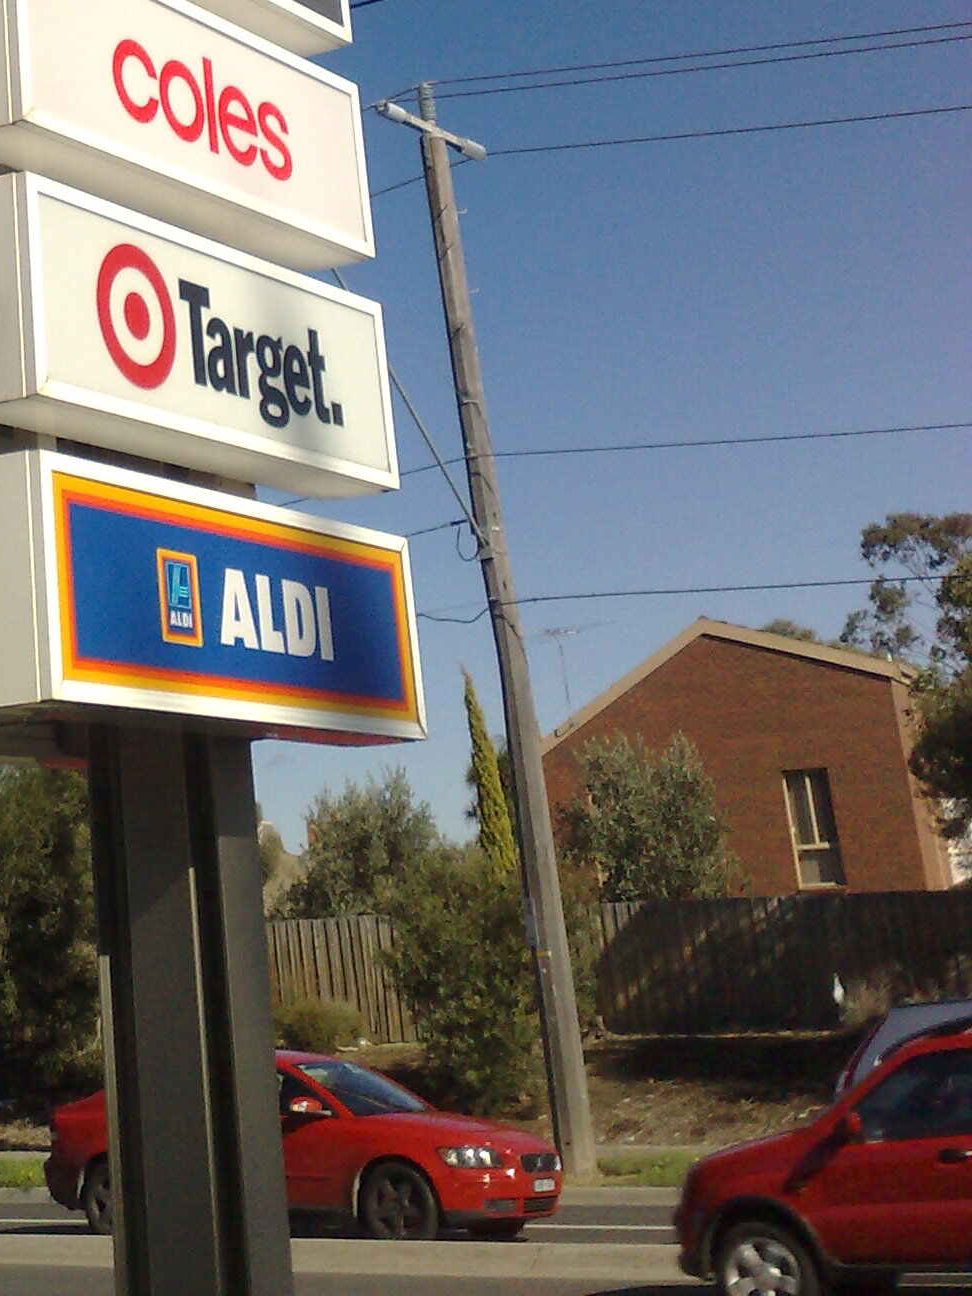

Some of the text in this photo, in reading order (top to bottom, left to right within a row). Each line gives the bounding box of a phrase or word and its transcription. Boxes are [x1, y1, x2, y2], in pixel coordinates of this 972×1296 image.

[112, 39, 293, 181] coles
[178, 278, 344, 428] Target.
[170, 609, 193, 628] ALDI
[220, 568, 335, 661] ALDI
